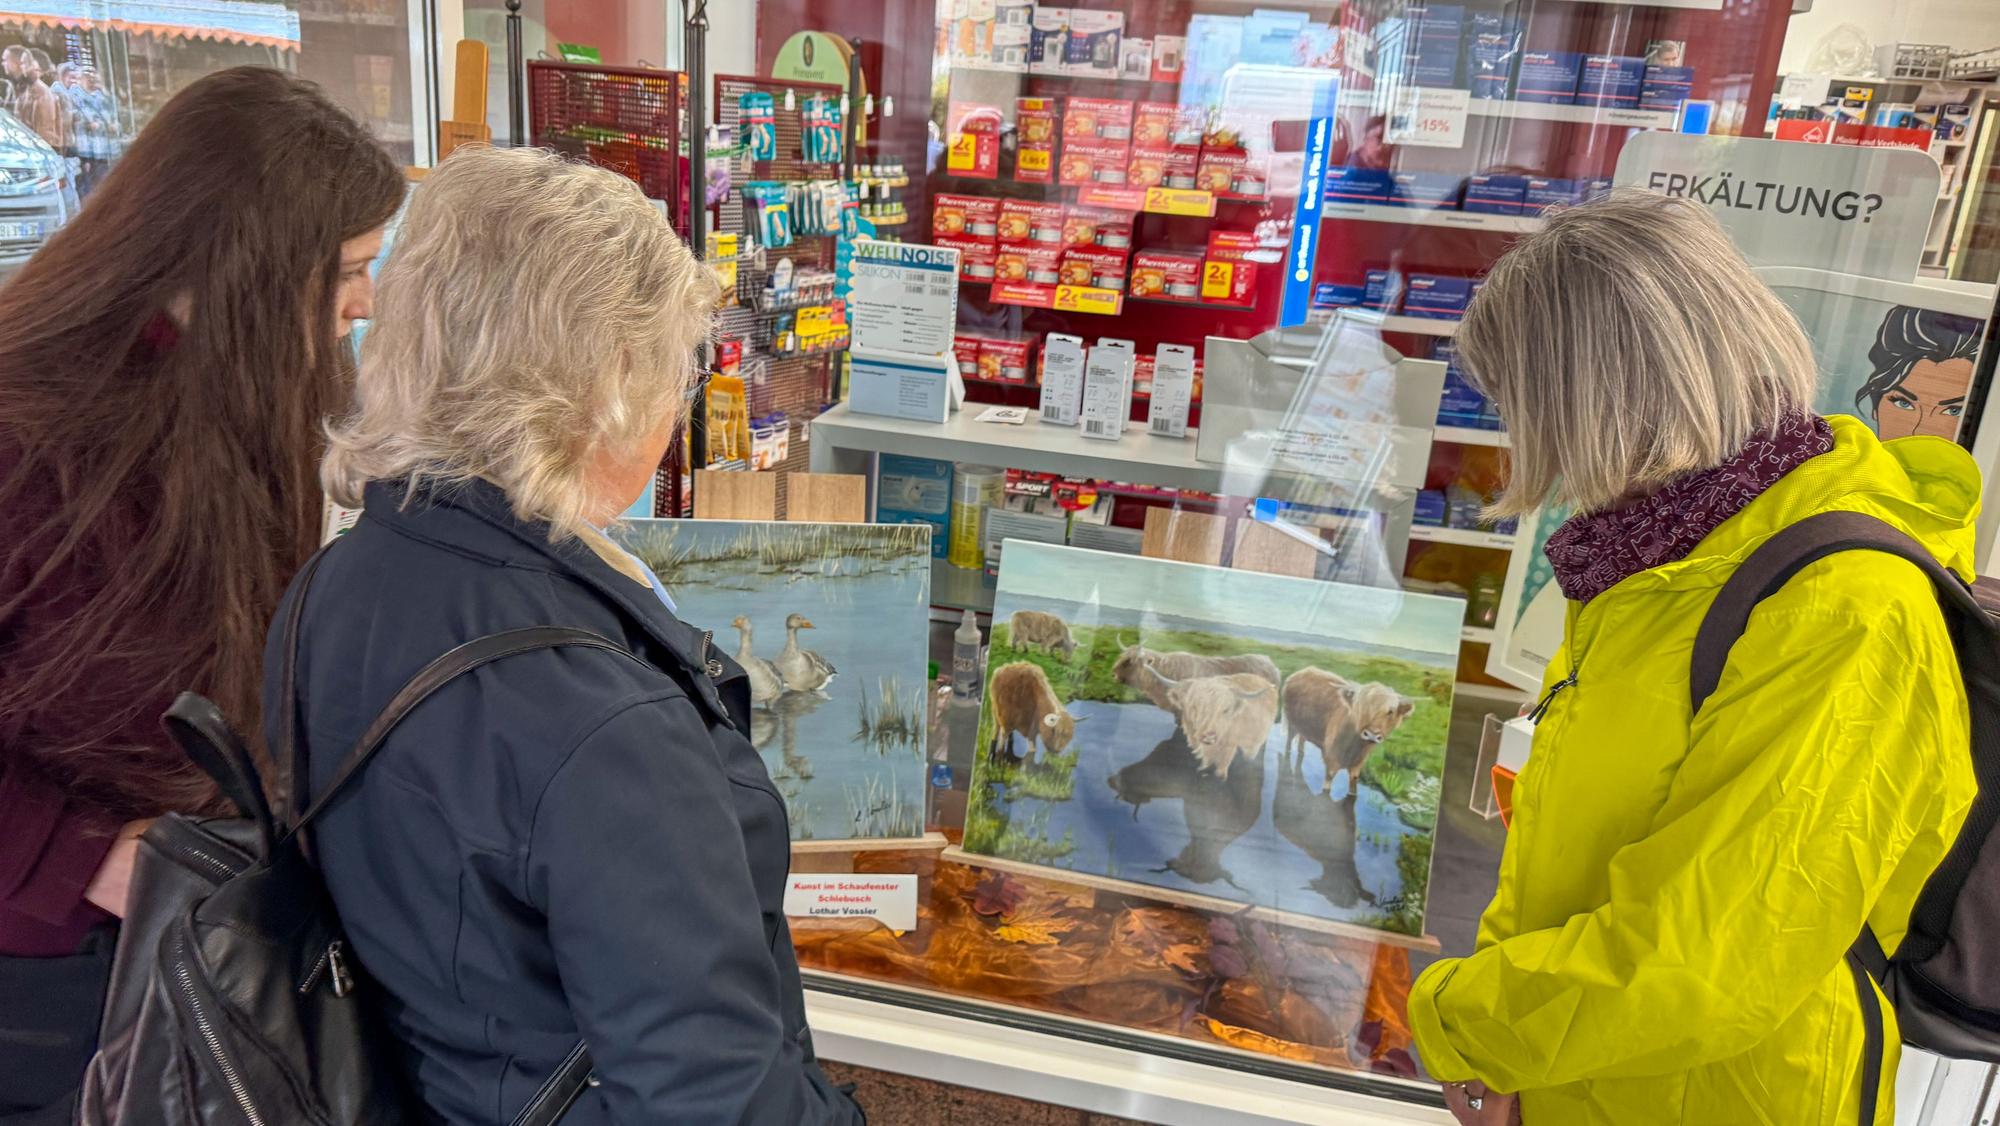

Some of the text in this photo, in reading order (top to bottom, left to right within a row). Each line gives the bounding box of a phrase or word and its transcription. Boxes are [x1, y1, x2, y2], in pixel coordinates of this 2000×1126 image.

[1069, 100, 1128, 112] ThermaCare
[1416, 119, 1450, 133] -15%
[1066, 144, 1125, 157] ThermaCare
[1135, 149, 1194, 162] ThermaCare
[939, 197, 995, 211] ThermaCare
[1649, 171, 1883, 223] ERKÄLTUNG?
[1003, 202, 1060, 216] ThermaCare
[937, 239, 993, 252] ThermaCare
[1001, 244, 1057, 258] ThermaCare
[858, 243, 955, 267] WELLNOISE
[1065, 250, 1122, 265] ThermaCare
[1137, 258, 1197, 272] ThermaCare
[857, 265, 900, 280] SILIKON
[1015, 482, 1050, 492] SPORT
[794, 882, 898, 890] Kunst im Schaufenster
[818, 894, 872, 902] Schlebusch
